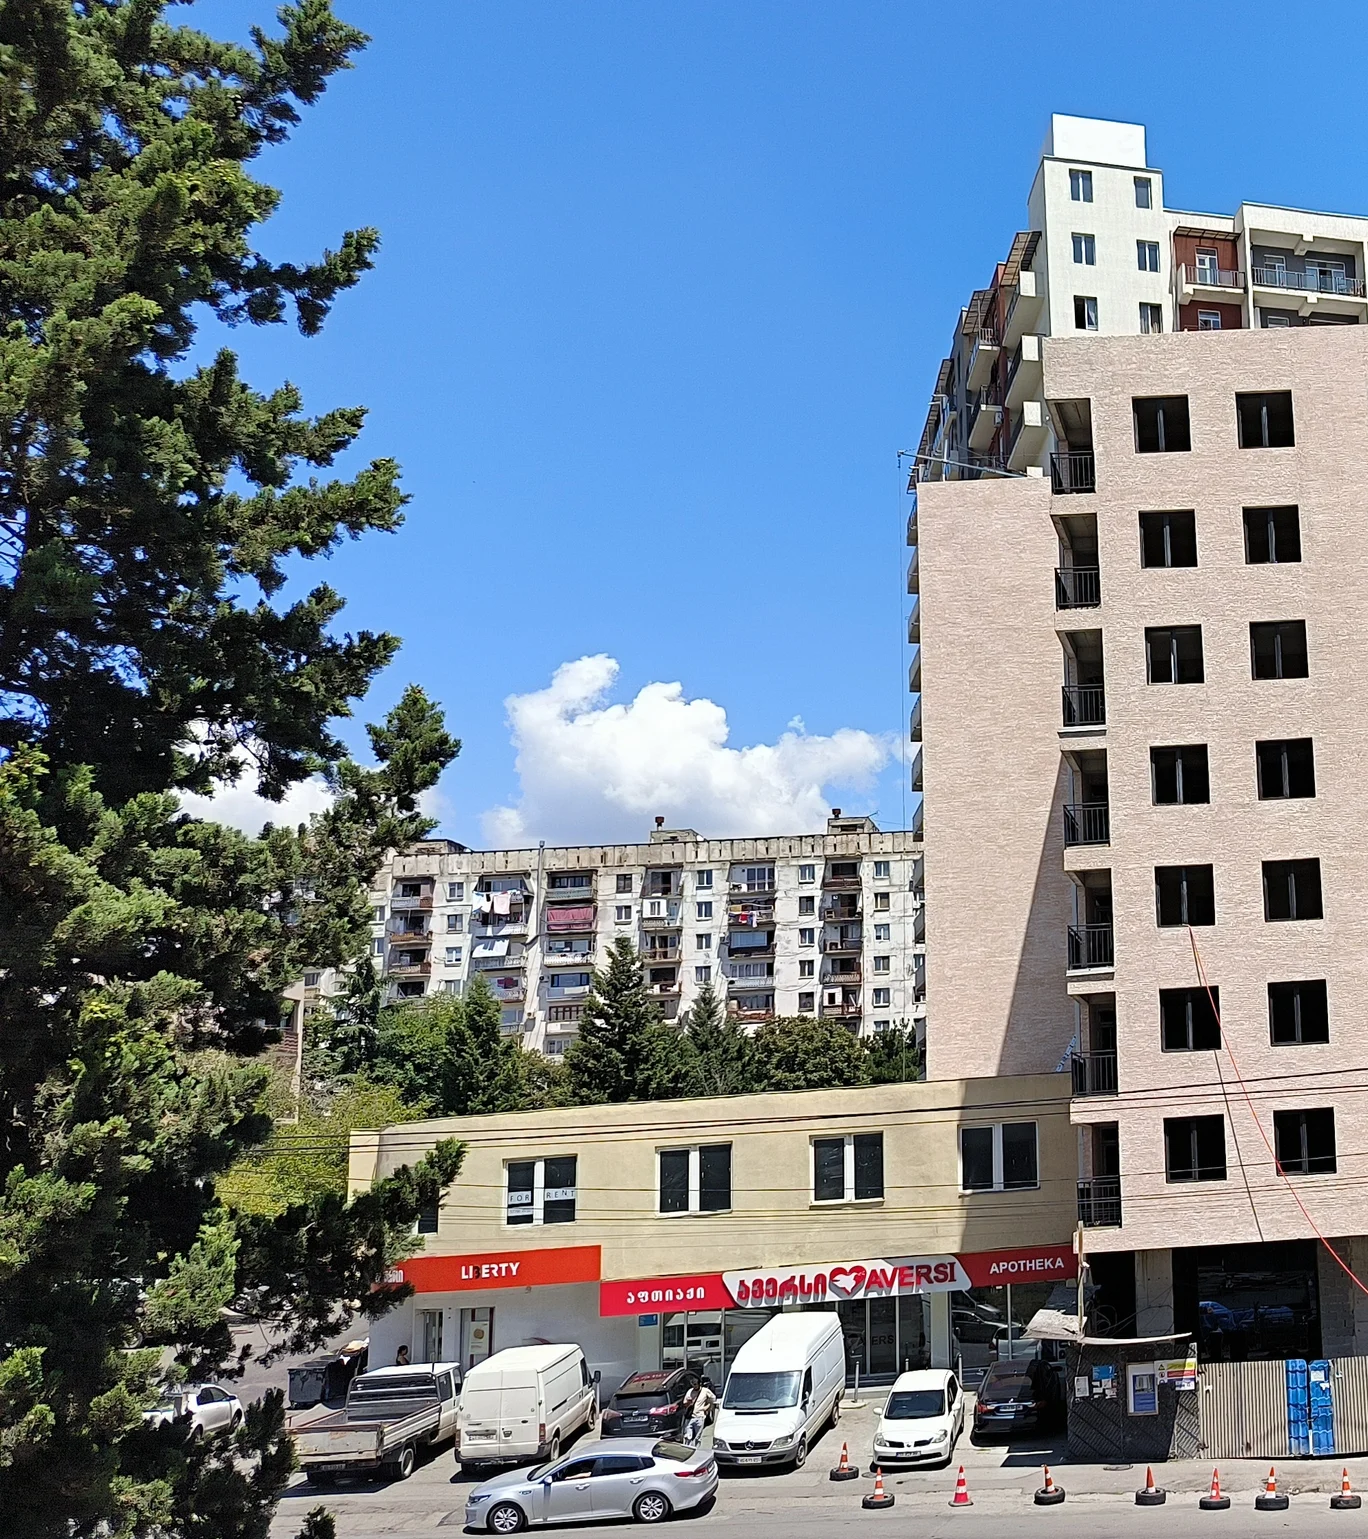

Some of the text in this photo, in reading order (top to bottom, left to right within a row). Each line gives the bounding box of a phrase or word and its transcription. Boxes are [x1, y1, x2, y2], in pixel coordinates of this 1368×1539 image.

[510, 1190, 575, 1202] FOR RENT
[461, 1262, 520, 1280] LIBERTY
[990, 1257, 1064, 1275] APOTHEKA
[864, 1261, 958, 1291] AVERSI
[626, 1287, 705, 1304] აფთიაქი
[737, 1273, 828, 1303] ავერსი
